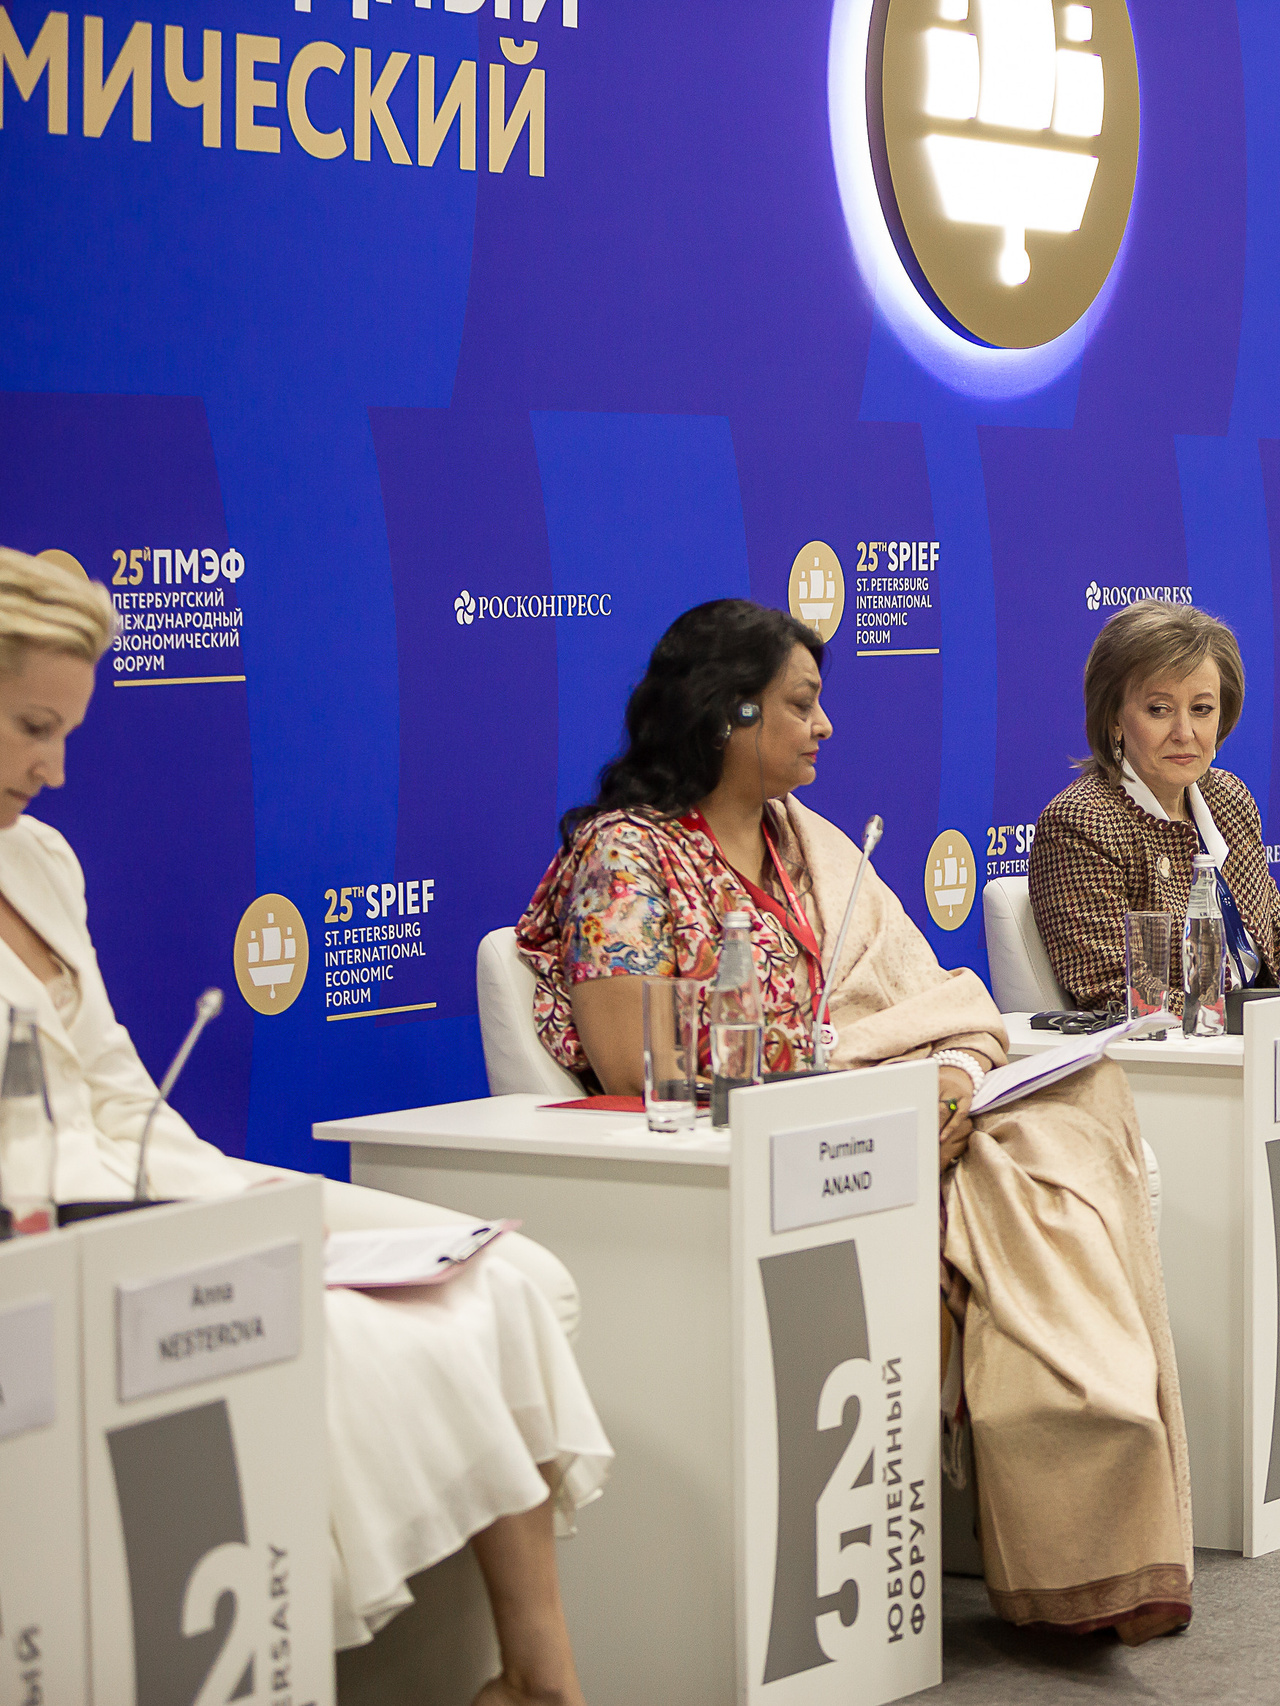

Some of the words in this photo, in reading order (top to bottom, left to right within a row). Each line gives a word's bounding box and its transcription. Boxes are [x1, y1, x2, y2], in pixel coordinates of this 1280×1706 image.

[0, 10, 546, 178] МИЧЕСКИЙ
[153, 548, 245, 584] ПМЭФ
[887, 541, 940, 572] SPIEF
[856, 577, 869, 592] ST.
[871, 577, 929, 592] PETERSBURG
[1102, 586, 1193, 606] ROSCONGRESS
[113, 588, 224, 609] ПЕТЕРБУРГСКИЙ
[478, 594, 612, 619] РОСКОНГРЕСС
[856, 595, 932, 610] INTERNATIONAL
[856, 612, 908, 627] ECONOMIC
[113, 629, 239, 652] ЭКОНОМИЧЕСКИЙ
[856, 630, 891, 644] FORUM
[113, 655, 165, 672] ФОРУМ
[987, 862, 999, 875] ST.
[366, 879, 435, 919] SPIEF
[324, 930, 342, 947] ST.
[344, 921, 421, 944] PETERSBURG
[325, 941, 426, 967] INTERNATIONAL
[325, 965, 394, 987] ECONOMIC
[326, 988, 371, 1007] FORUM
[819, 1136, 875, 1162] Purnima
[822, 1170, 872, 1198] ANAND
[158, 1317, 265, 1361] NESTEROVA
[883, 1357, 904, 1644] ЮБИЛЕЙНЫЙ
[909, 1479, 926, 1635] ФОРУМ
